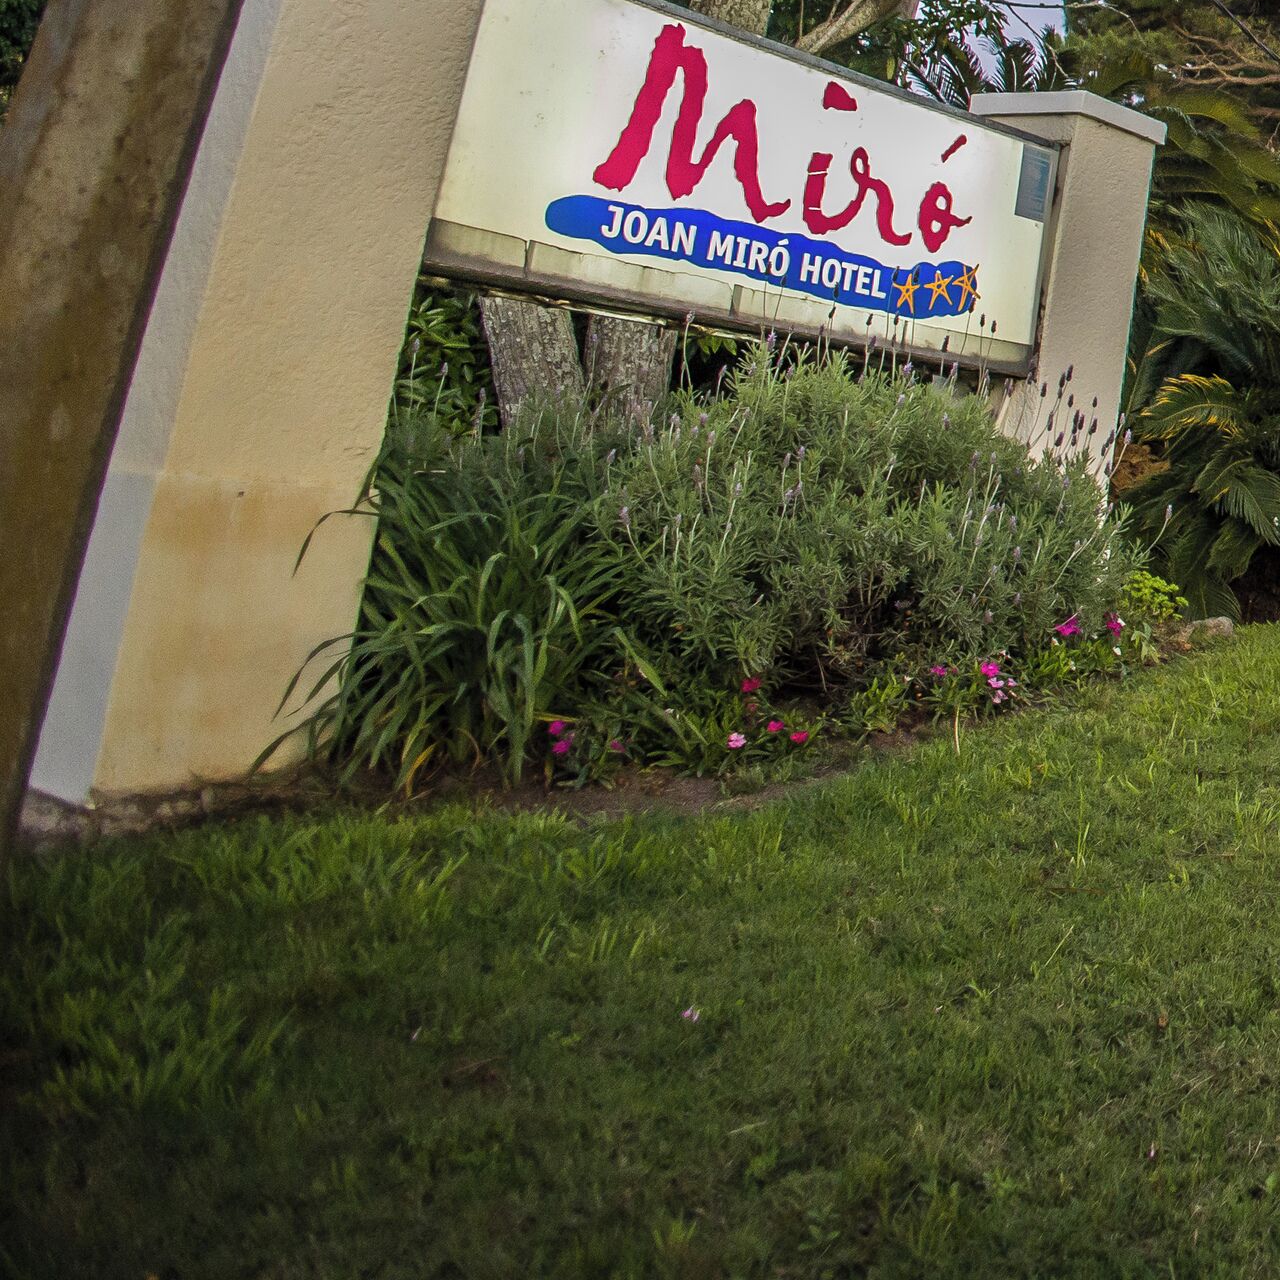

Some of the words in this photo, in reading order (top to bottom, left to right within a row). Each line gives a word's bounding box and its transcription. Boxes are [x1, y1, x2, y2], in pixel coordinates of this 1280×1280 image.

[593, 23, 972, 252] Miró
[601, 204, 697, 256] JOAN
[706, 231, 791, 277] MIRÓ
[800, 253, 887, 299] HOTEL
